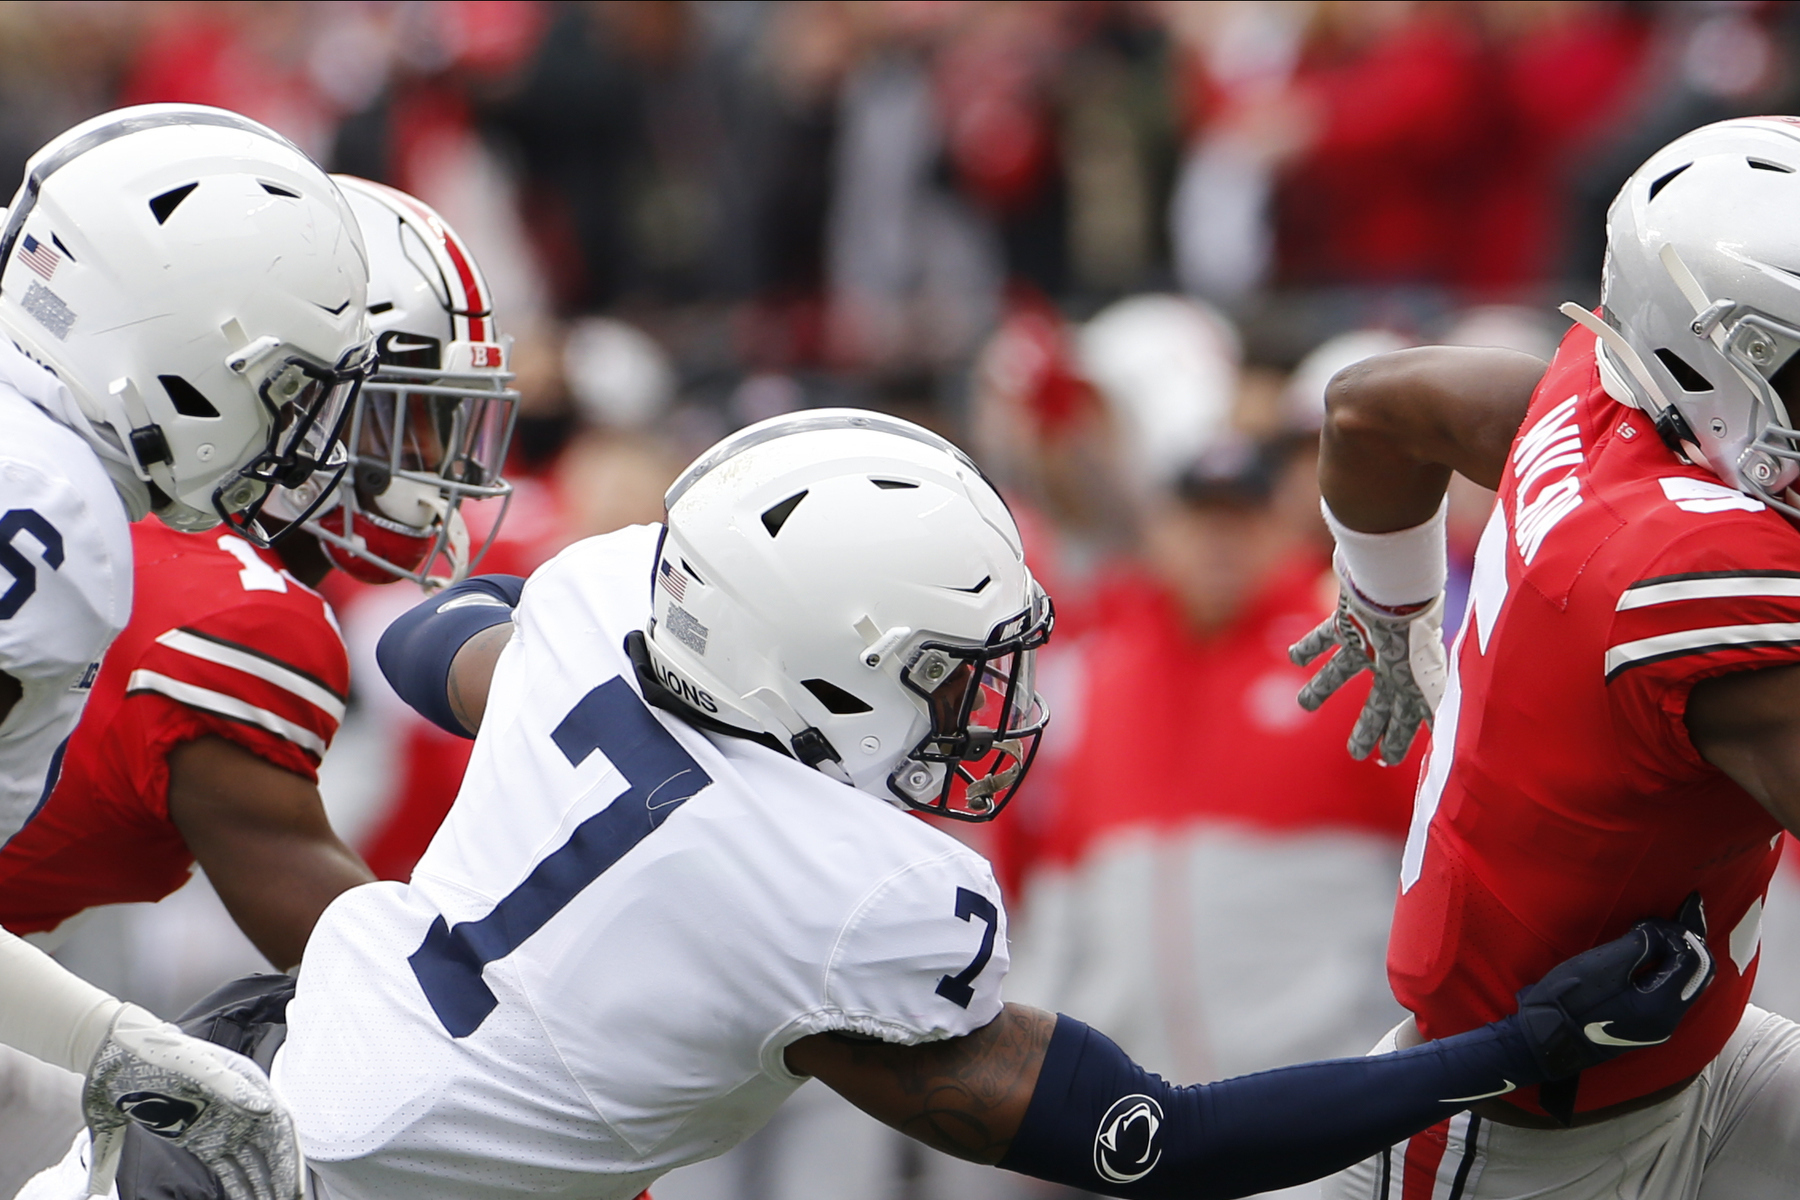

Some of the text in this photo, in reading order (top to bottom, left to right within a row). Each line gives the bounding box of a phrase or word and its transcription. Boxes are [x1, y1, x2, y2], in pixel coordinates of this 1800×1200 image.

[999, 615, 1027, 642] NIKE
[653, 656, 719, 714] LIONS
[407, 674, 714, 1039] 7
[934, 886, 998, 1010] 7
